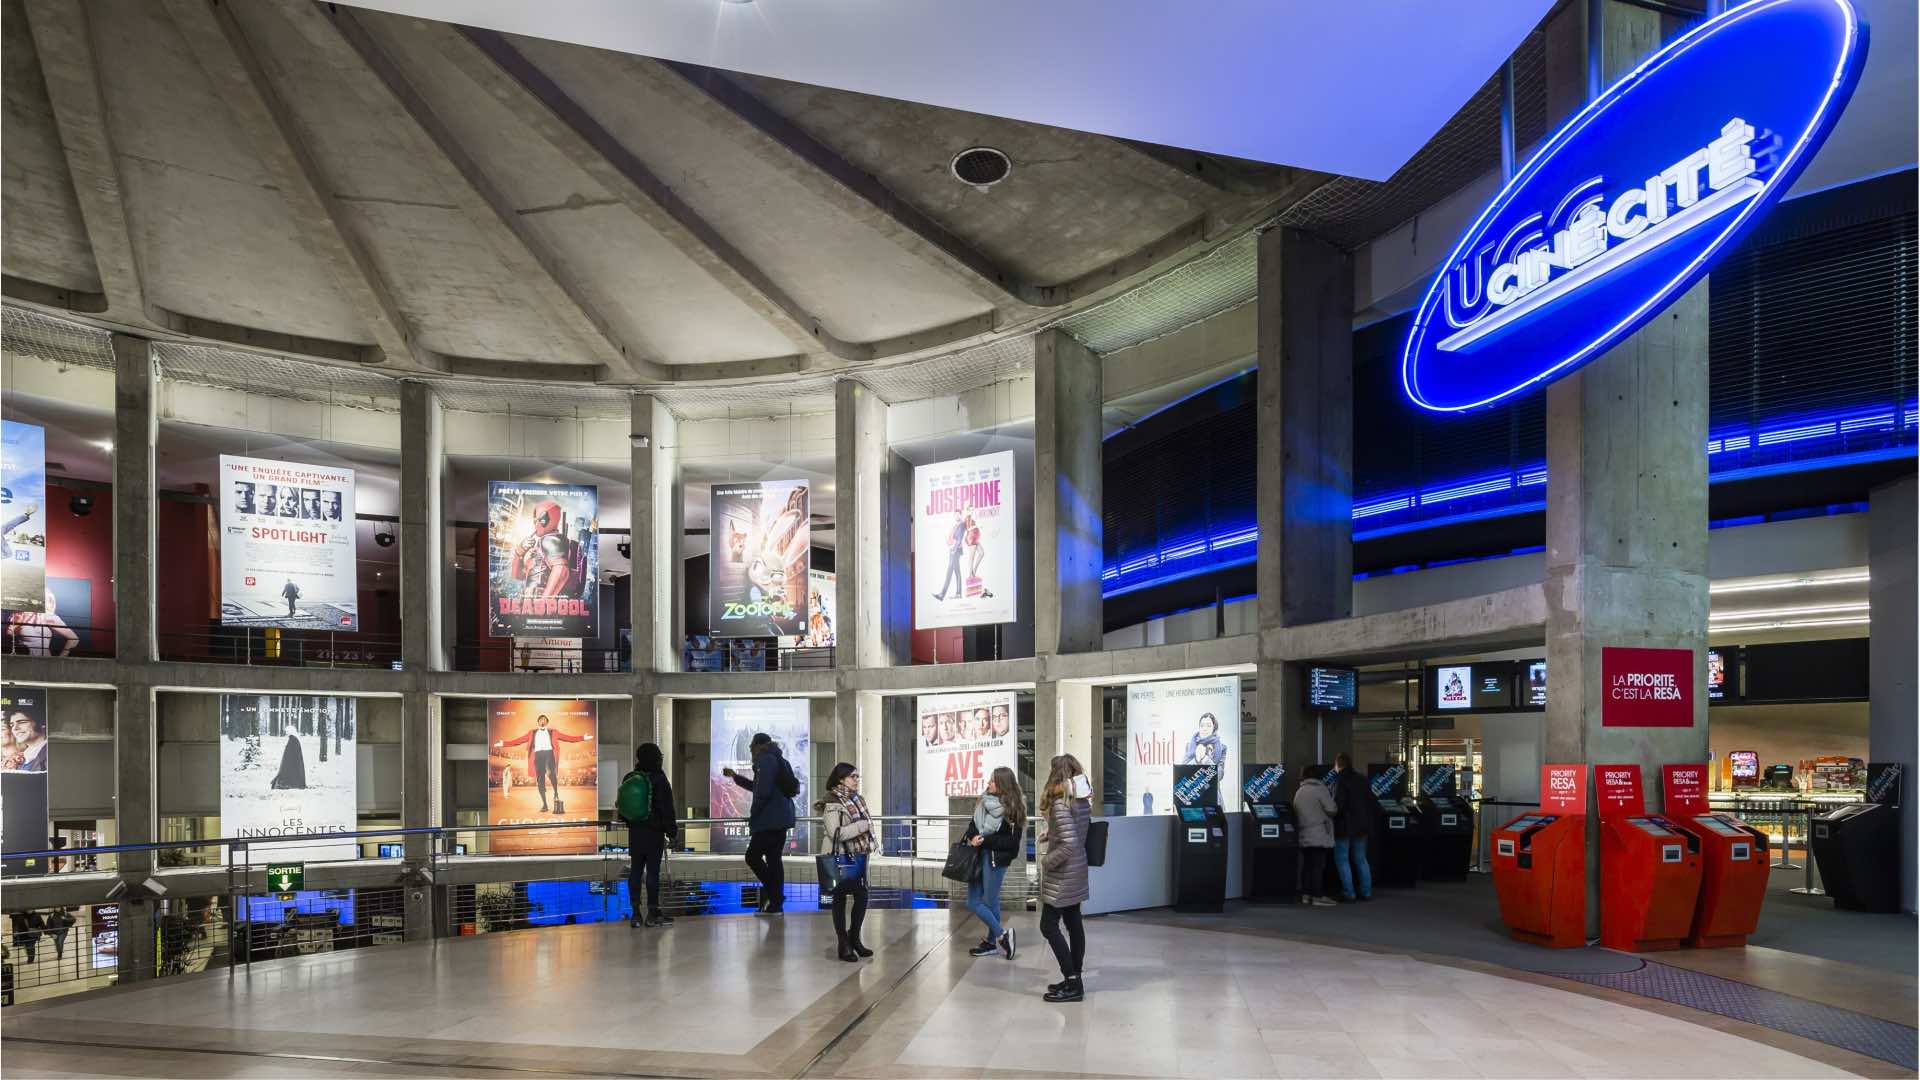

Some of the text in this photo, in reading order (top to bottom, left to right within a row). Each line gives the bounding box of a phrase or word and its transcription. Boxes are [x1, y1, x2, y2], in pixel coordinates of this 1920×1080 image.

[251, 527, 328, 544] SPOTLIGHT
[499, 597, 591, 616] DEADPOOL
[1613, 674, 1626, 686] LA
[1612, 686, 1682, 700] C'EST LA RESA
[1134, 729, 1175, 766] Nahid
[945, 749, 984, 782] AVE
[1550, 778, 1576, 789] RESA
[724, 827, 742, 836] THE
[268, 866, 302, 875] SORTIE
